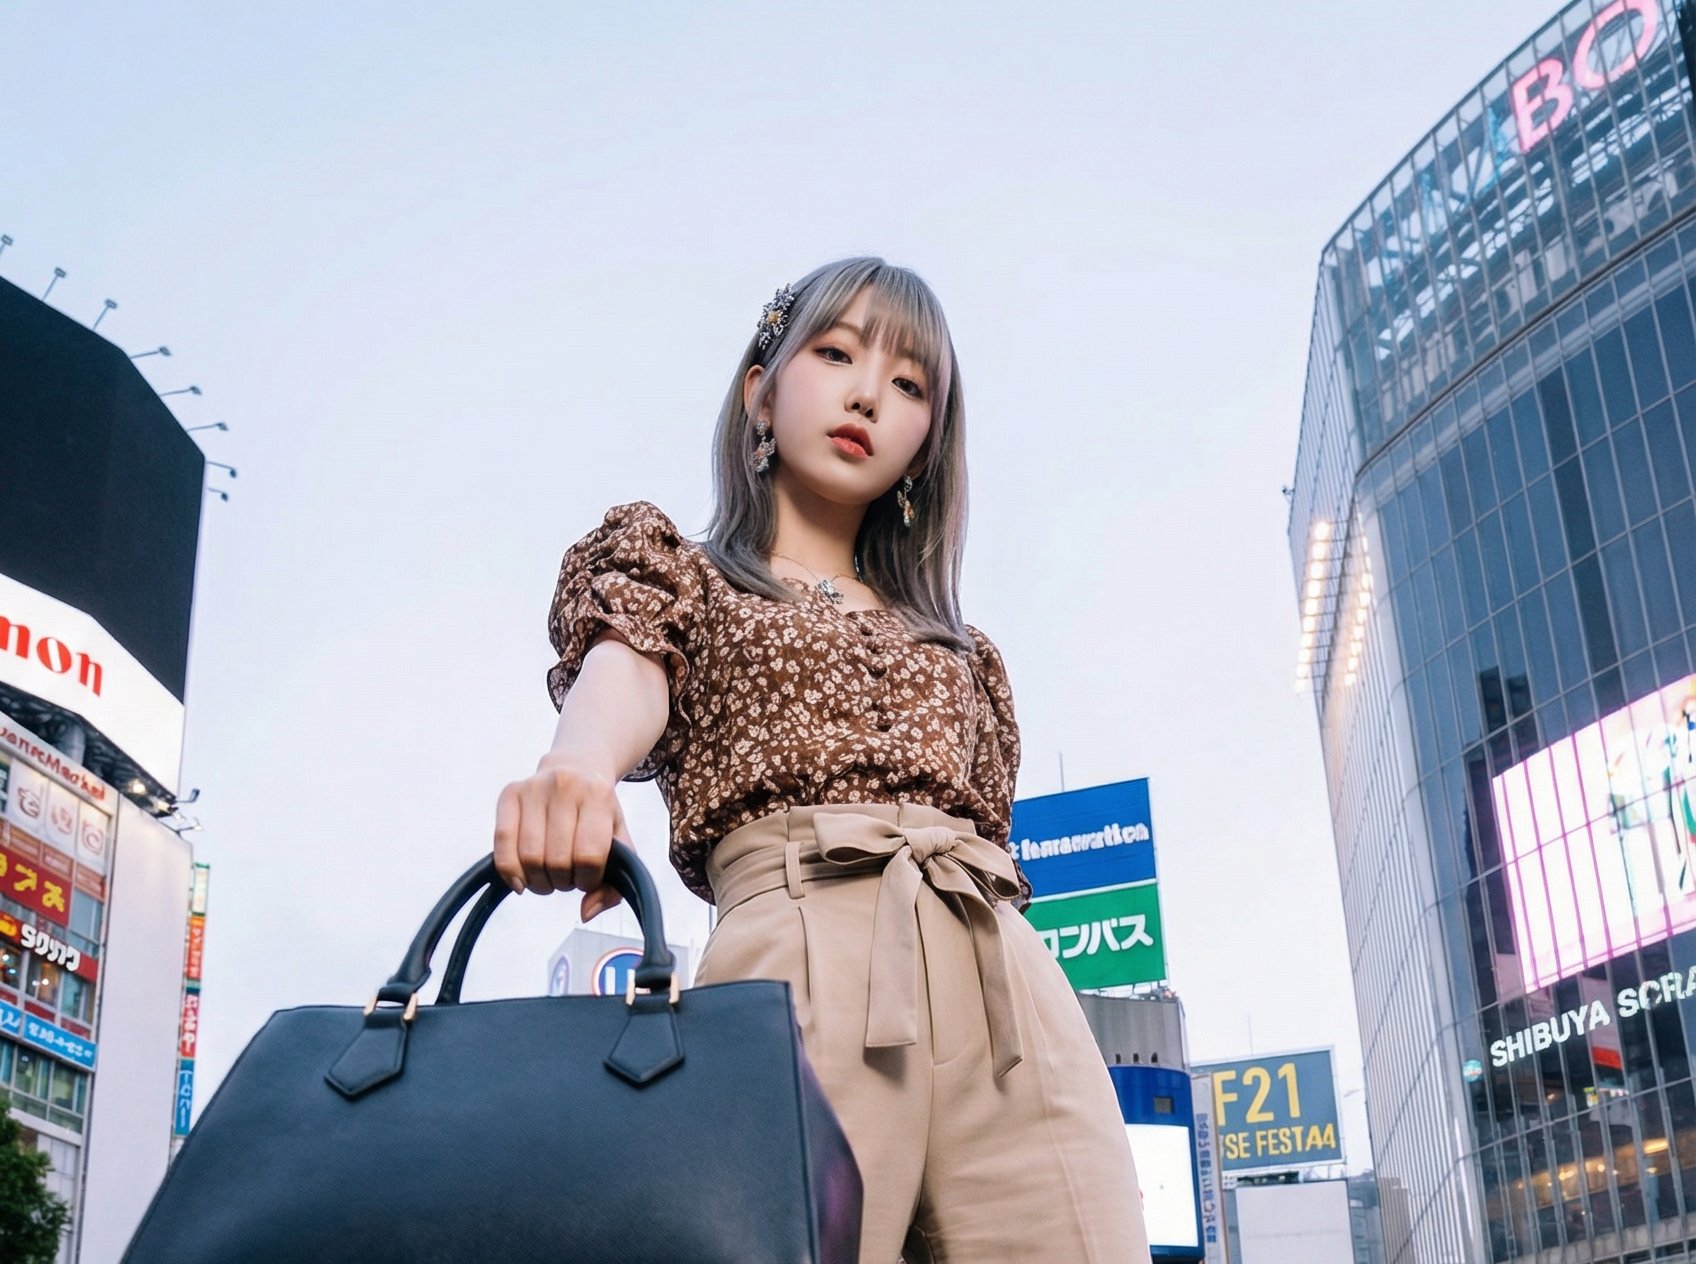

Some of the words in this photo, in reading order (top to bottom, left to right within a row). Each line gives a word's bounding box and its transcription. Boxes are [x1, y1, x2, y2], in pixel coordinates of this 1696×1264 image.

[0, 615, 102, 697] non
[1490, 1000, 1611, 1068] SHIBUYA
[1213, 1062, 1301, 1126] F21
[1219, 1132, 1251, 1160] SE
